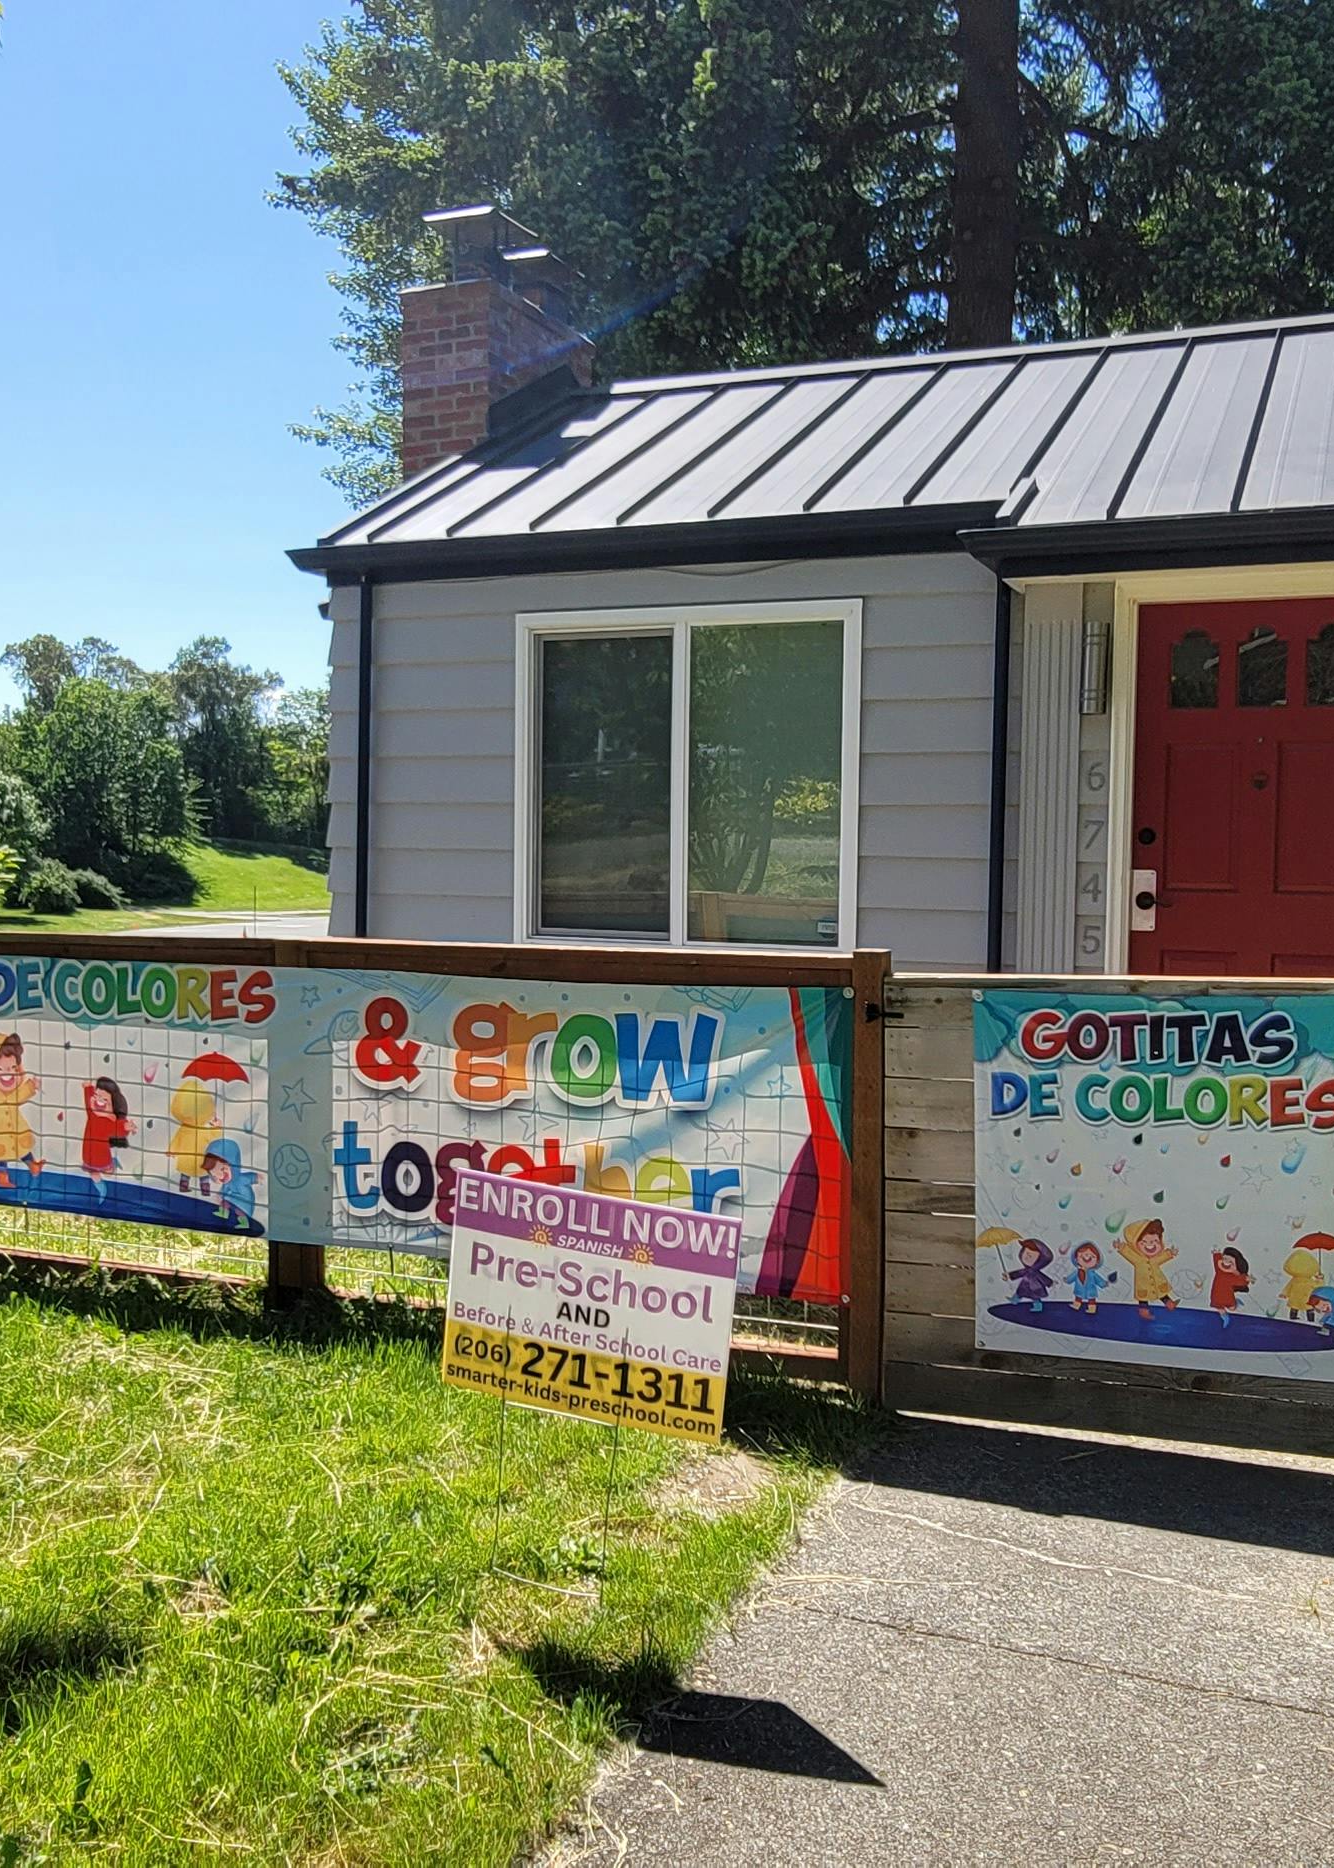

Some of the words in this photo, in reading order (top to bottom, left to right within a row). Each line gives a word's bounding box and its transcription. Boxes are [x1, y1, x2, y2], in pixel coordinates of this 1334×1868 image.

[1081, 762, 1106, 955] 6745
[53, 963, 276, 1024] COLORES
[355, 996, 422, 1084] &
[453, 1002, 719, 1102] grow
[1020, 1010, 1295, 1065] GOTITAS
[991, 1071, 1060, 1118] DE
[459, 1178, 610, 1236] ENROLL
[623, 1209, 737, 1260] NOW!
[556, 1234, 624, 1259] SPANISH
[470, 1241, 713, 1324] Pre-School
[556, 1302, 610, 1329] AND
[454, 1301, 516, 1331] Before
[521, 1318, 535, 1335] &
[539, 1321, 590, 1347] After
[595, 1333, 666, 1364] School
[671, 1349, 722, 1373] Care
[446, 1363, 717, 1437] smarter-kids-preschool.com
[454, 1333, 512, 1367] (206)
[521, 1342, 715, 1416] 271-1311
